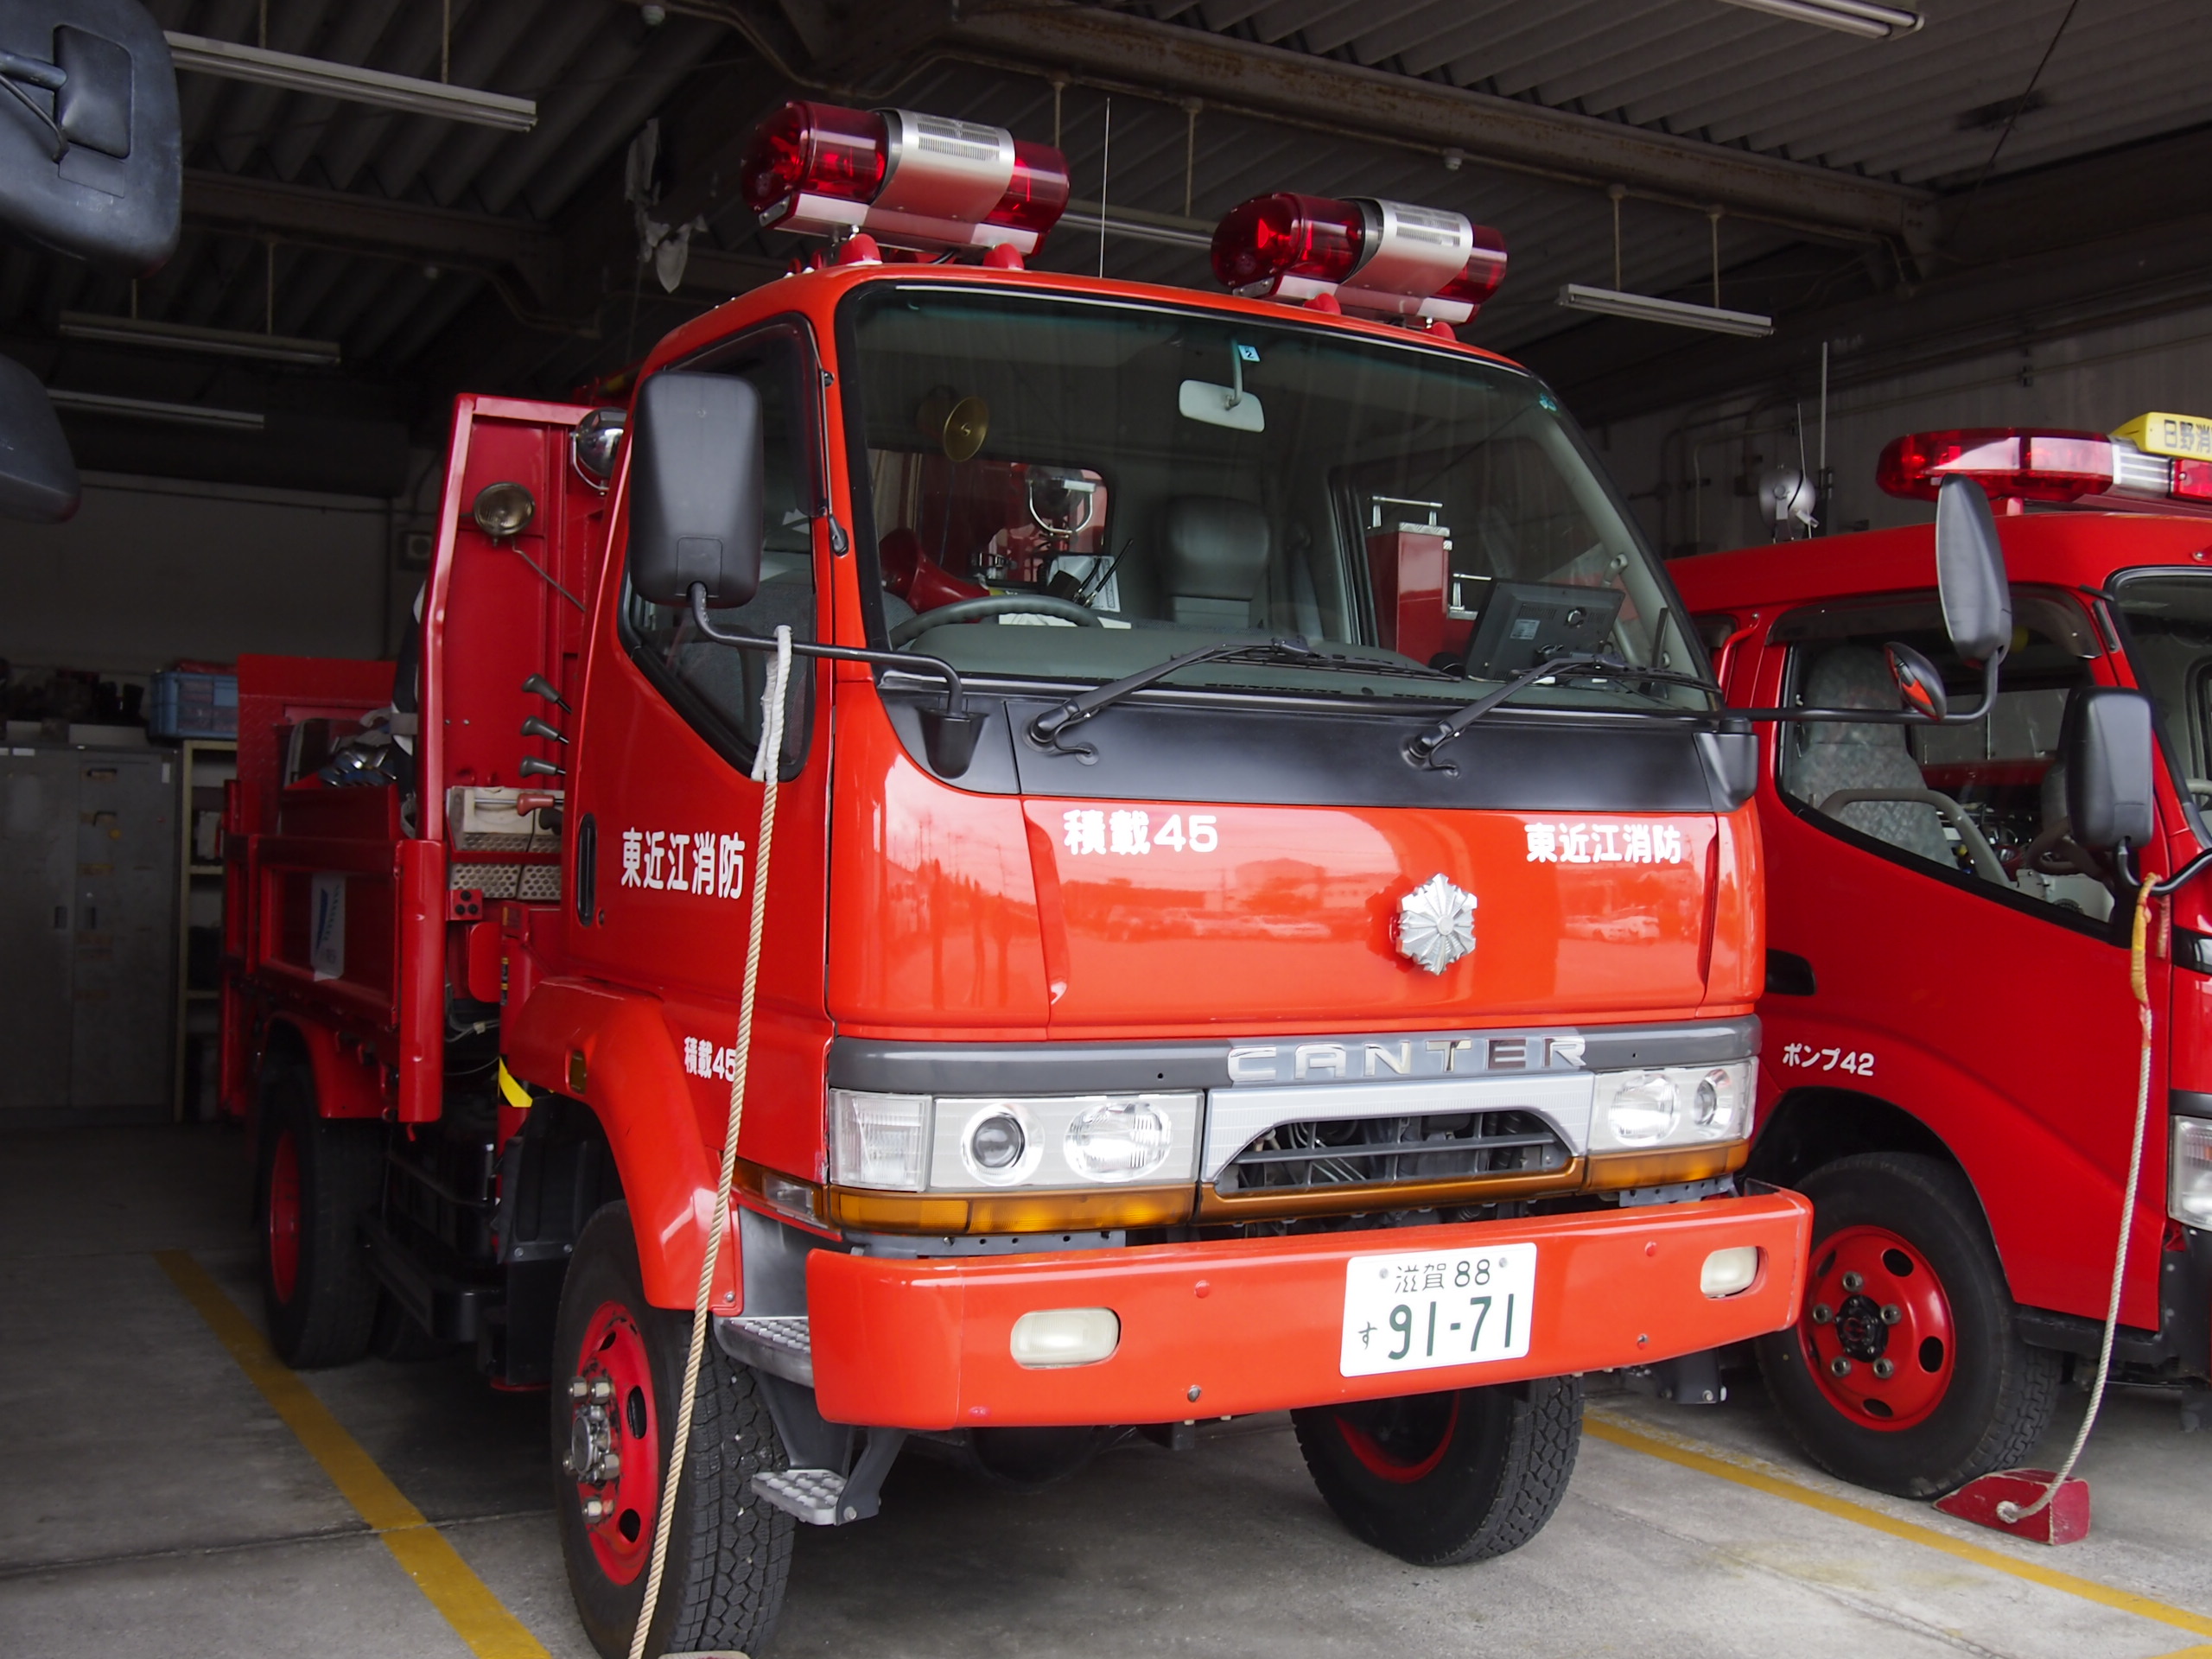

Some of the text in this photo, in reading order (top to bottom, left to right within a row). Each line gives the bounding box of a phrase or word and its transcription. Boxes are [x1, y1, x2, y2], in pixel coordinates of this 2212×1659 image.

[2164, 419, 2212, 453] 日野消
[1063, 809, 1218, 855] 積載45
[1524, 822, 1681, 864] 東近江消防
[621, 826, 746, 899] 東近江消防
[683, 1036, 736, 1082] 積載45
[1227, 1035, 1586, 1081] CANTER
[1783, 1042, 1875, 1077] ポンプ42
[1454, 1258, 1491, 1287] 88
[1388, 1294, 1515, 1360] 91-71
